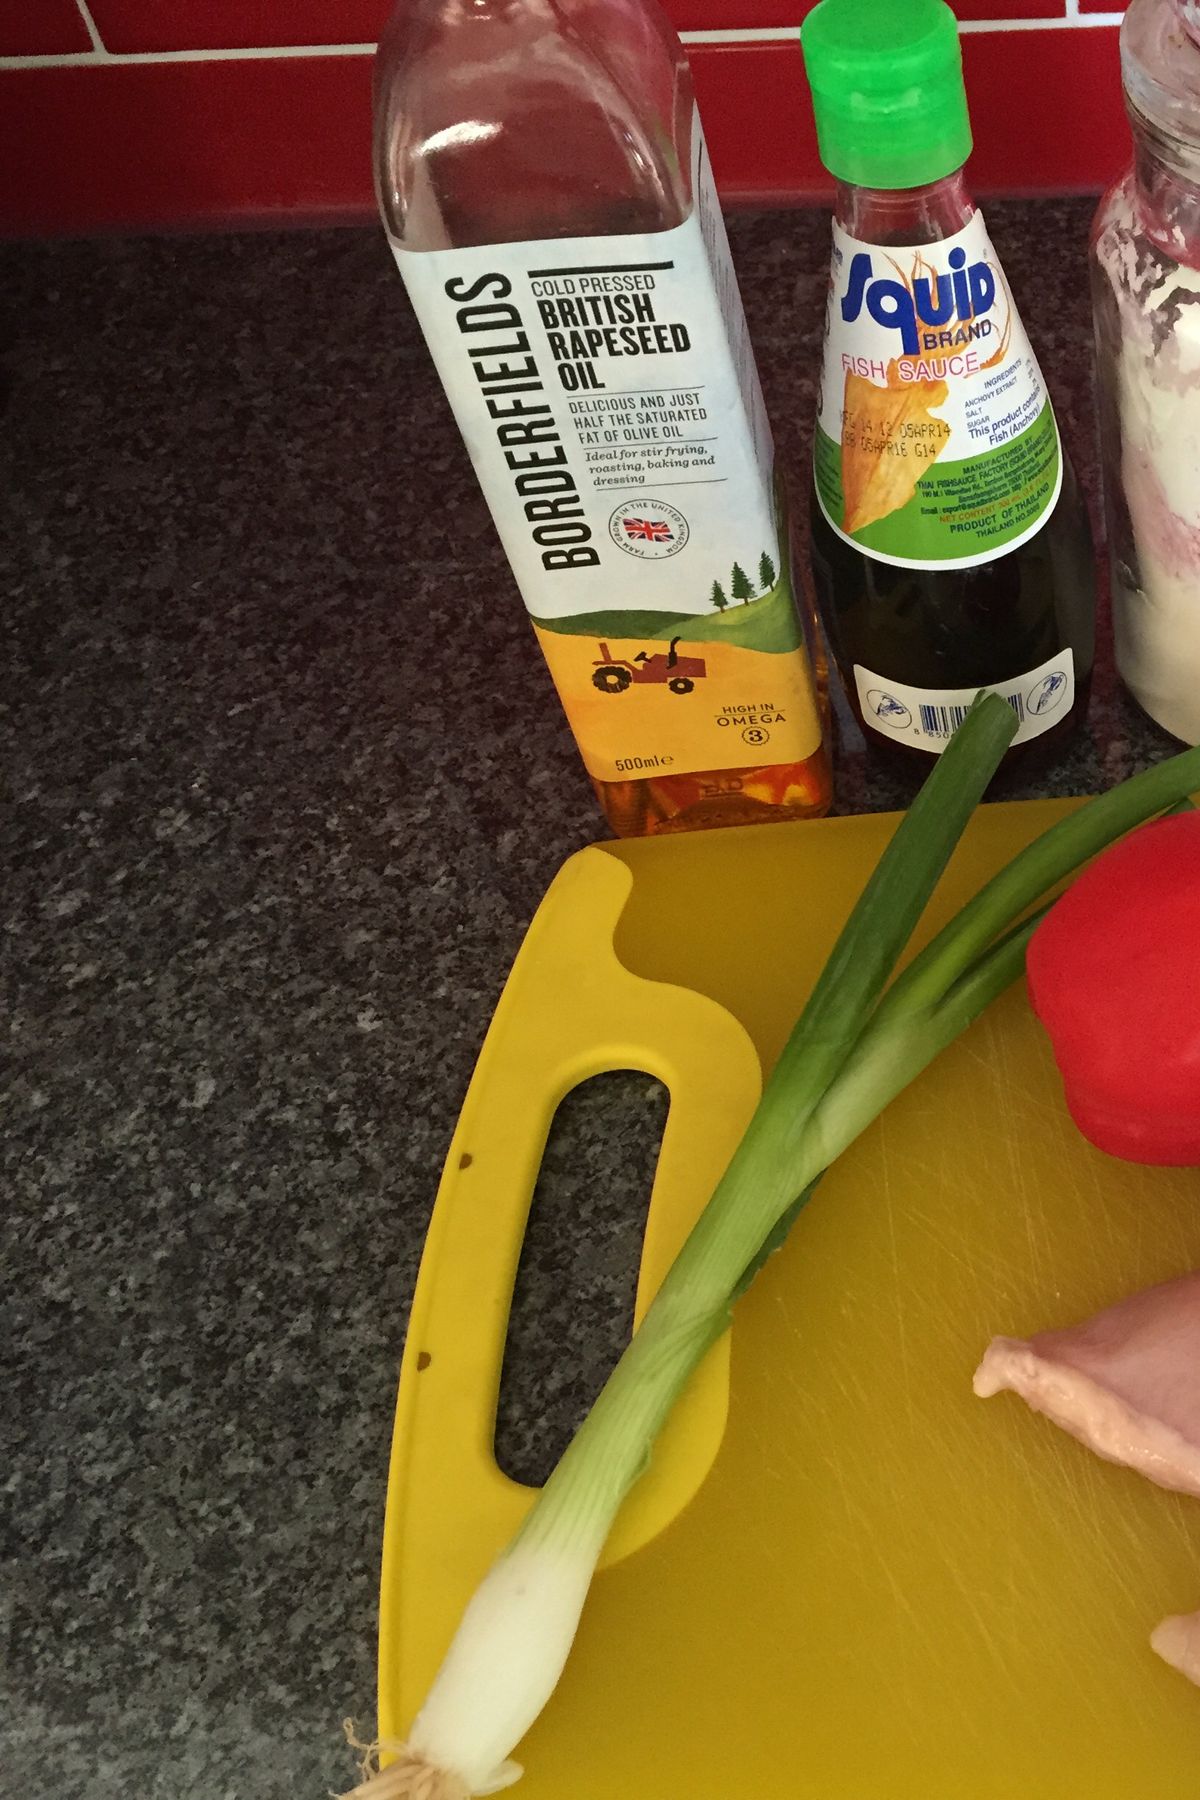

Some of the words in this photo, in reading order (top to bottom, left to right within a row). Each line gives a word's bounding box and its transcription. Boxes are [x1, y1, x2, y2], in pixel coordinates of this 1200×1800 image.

[531, 279, 576, 297] COLD
[579, 274, 656, 293] PRESSED
[537, 293, 656, 329] BRITISH
[547, 323, 691, 360] RAPESEED
[923, 318, 992, 350] BRAND
[557, 361, 606, 391] OIL
[841, 353, 885, 380] FISH
[899, 351, 981, 381] SAUCE
[984, 358, 1022, 389] INGREDIENTS
[569, 397, 636, 414] DELICIOUS
[640, 395, 665, 408] AND
[669, 393, 701, 407] JUST
[964, 390, 995, 408] ANCHOVY
[445, 273, 600, 570] BORDERFIELDS
[574, 415, 605, 429] HALF
[608, 413, 634, 426] THE
[636, 408, 707, 425] SATURATED
[965, 407, 982, 418] SALT
[966, 415, 990, 429] SUGAR
[968, 425, 990, 439] This
[991, 406, 1023, 432] product
[578, 431, 601, 444] FAT
[604, 430, 619, 442] OF
[623, 426, 659, 441] OLIVE
[662, 425, 684, 438] OIL
[989, 430, 1009, 445] Fish
[585, 450, 618, 462] Ideal
[619, 449, 638, 464] for
[640, 447, 663, 457] stir
[663, 445, 708, 458] frying,
[589, 461, 645, 475] roasting,
[647, 459, 689, 470] baking
[691, 455, 716, 467] and
[593, 474, 645, 486] dressing
[620, 507, 630, 516] IN
[630, 502, 648, 510] THE
[651, 502, 681, 522] UNITED
[950, 515, 997, 533] PRODUCT
[1001, 507, 1014, 519] OF
[1015, 482, 1050, 513] THAILAND
[612, 516, 624, 542] GROWN
[666, 523, 685, 554] KINGDOM
[976, 520, 1015, 538] THAILAND
[622, 542, 645, 556] FARM
[722, 704, 757, 714] HIGH
[760, 703, 775, 712] IN
[717, 713, 787, 727] OMEGA
[748, 730, 764, 743] 3
